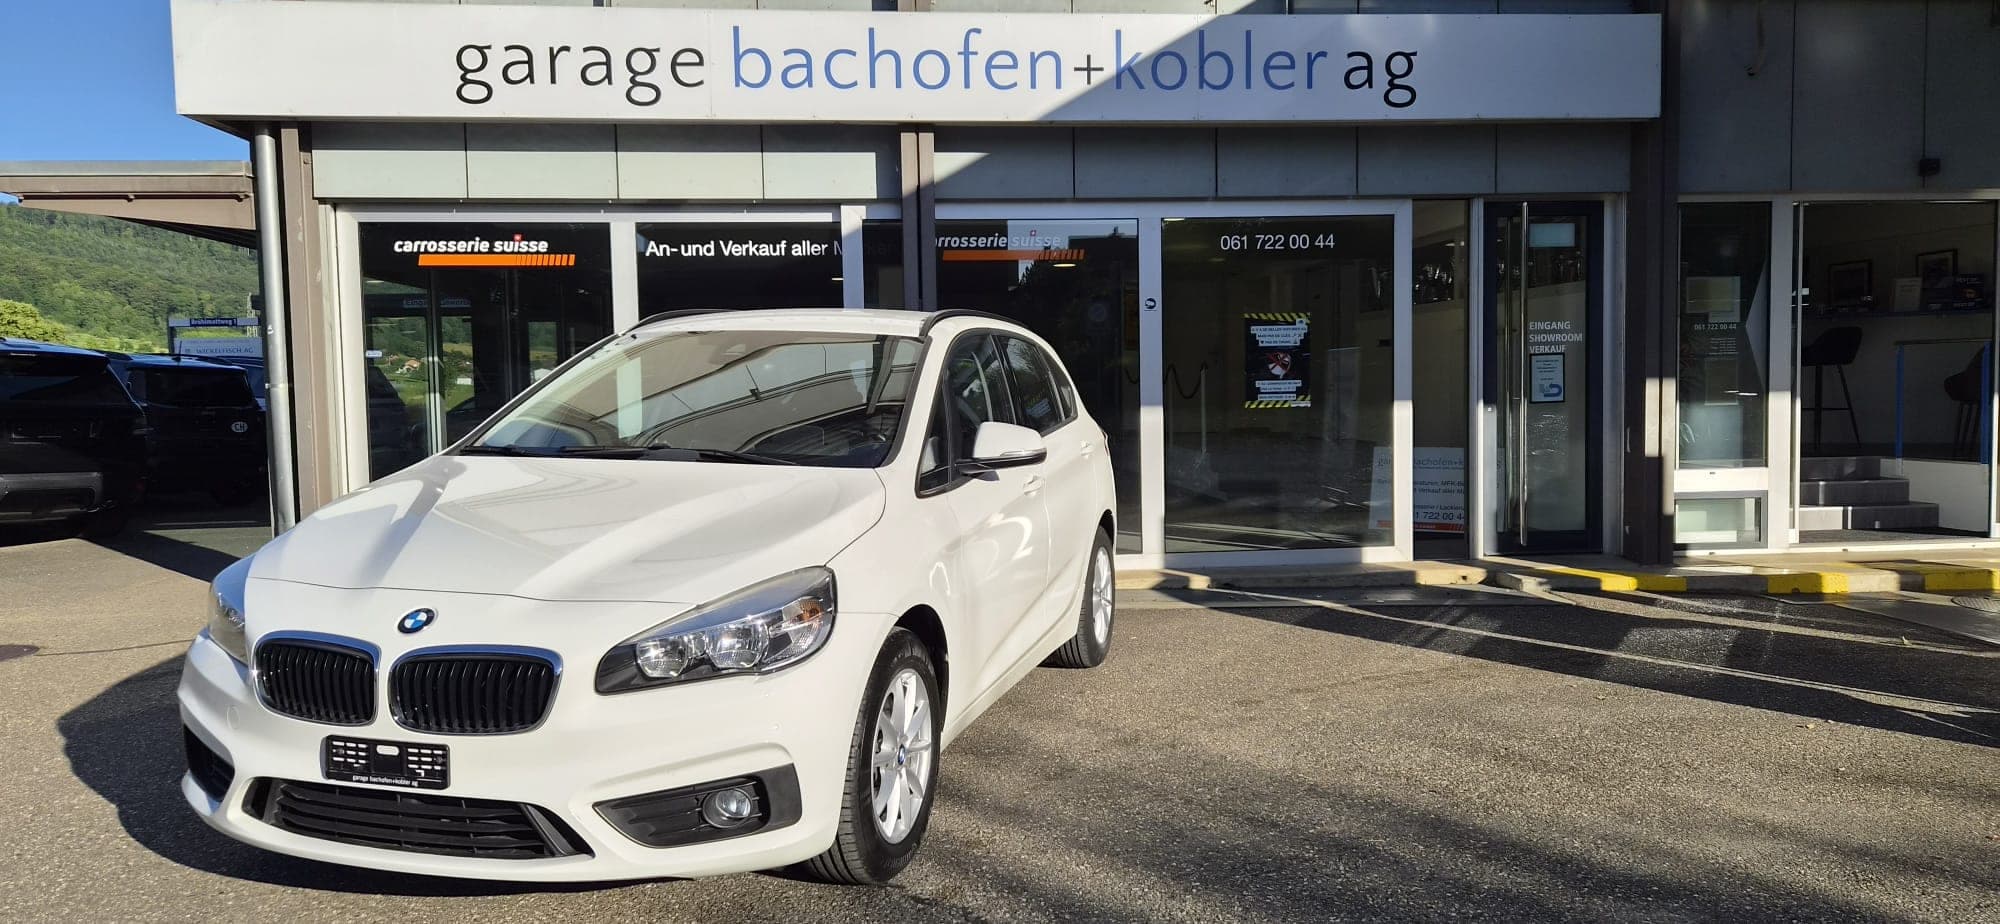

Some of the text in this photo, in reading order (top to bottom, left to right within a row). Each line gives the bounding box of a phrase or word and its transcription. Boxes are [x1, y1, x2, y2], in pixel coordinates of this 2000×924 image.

[455, 43, 705, 106] garage
[1343, 50, 1418, 107] ag
[393, 233, 549, 253] carrosserie suisse
[934, 229, 1062, 248] rrosserie suisse
[1220, 234, 1335, 250] 061 722 00 44
[719, 240, 788, 257] Verkauf
[791, 240, 829, 257] aller
[1529, 321, 1571, 330] EINGANG
[1529, 333, 1583, 342] SHOWROOM
[1529, 345, 1566, 353] VERKAUF
